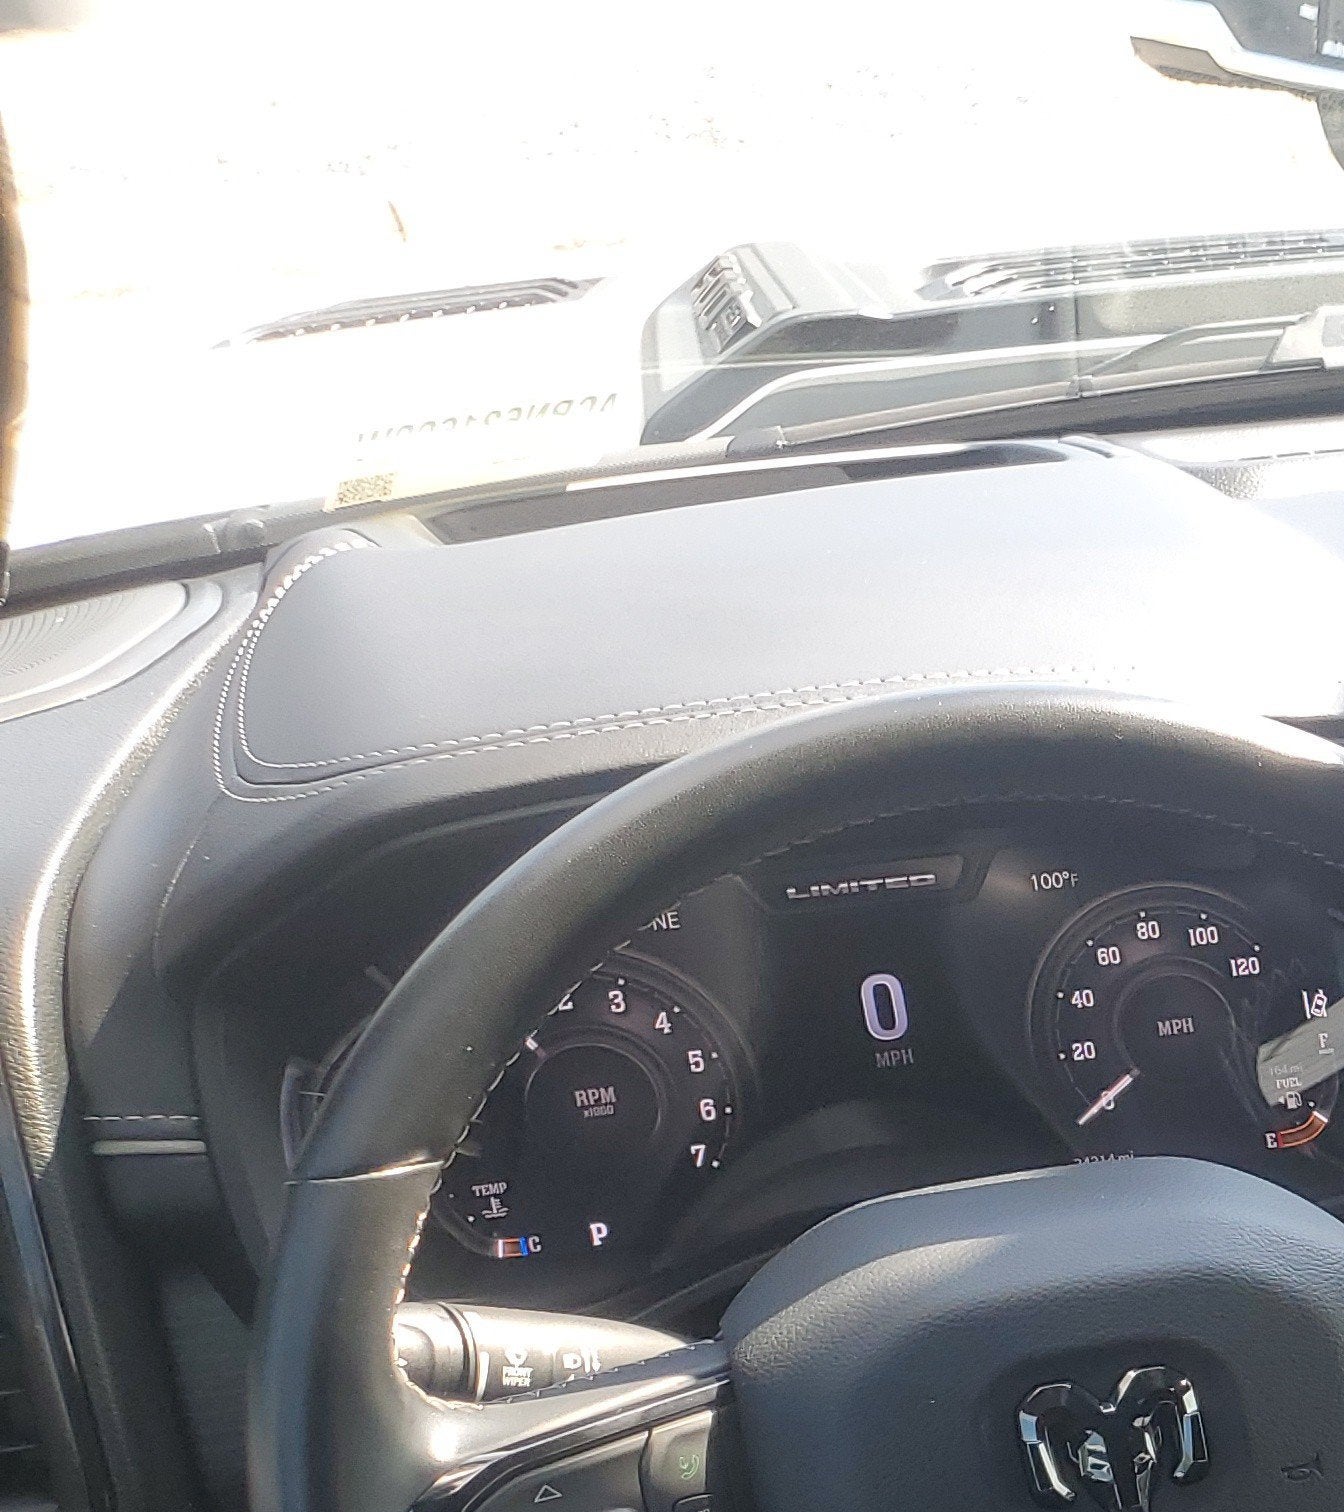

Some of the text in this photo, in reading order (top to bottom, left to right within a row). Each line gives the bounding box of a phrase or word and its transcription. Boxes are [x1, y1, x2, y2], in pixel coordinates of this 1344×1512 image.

[786, 872, 937, 900] LIMITED
[1029, 870, 1080, 892] 100°F
[653, 911, 682, 932] NE
[1136, 920, 1161, 941] 80
[1188, 926, 1219, 947] 100
[1097, 946, 1122, 967] 60
[1230, 957, 1261, 978] 120
[608, 990, 627, 1014] 3
[860, 972, 909, 1041] 0
[1071, 989, 1096, 1009] 40
[655, 1011, 673, 1035] 4
[1157, 1017, 1195, 1037] MPH
[688, 1050, 706, 1074] 5
[874, 1048, 915, 1069] MPH
[1071, 1041, 1097, 1062] 20
[1275, 1077, 1303, 1089] FUEL
[574, 1085, 617, 1108] RPM
[699, 1098, 717, 1122] 6
[1265, 1132, 1278, 1149] E
[691, 1144, 706, 1168] 7
[471, 1181, 508, 1197] TEMP
[528, 1235, 542, 1253] C
[589, 1222, 609, 1246] P
